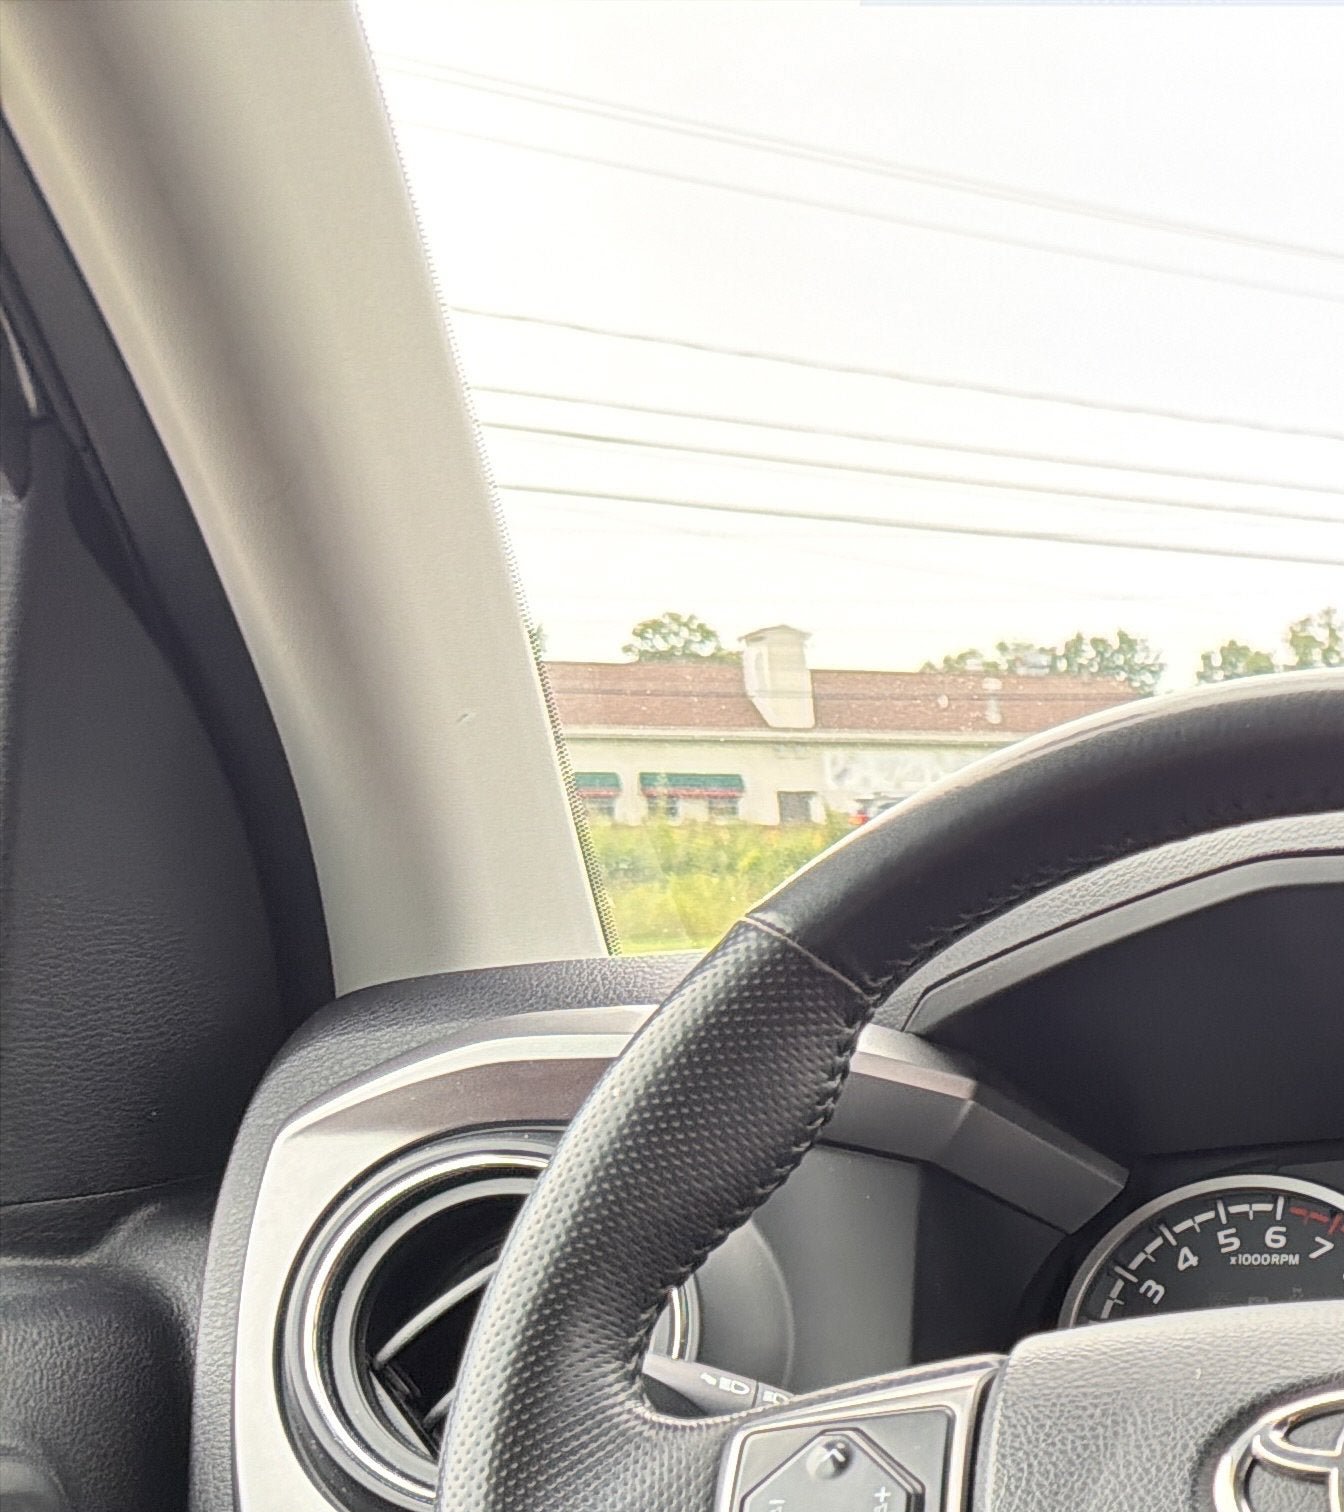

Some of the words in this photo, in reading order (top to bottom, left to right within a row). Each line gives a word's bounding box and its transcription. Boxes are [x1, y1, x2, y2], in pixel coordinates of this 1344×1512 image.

[1216, 1228, 1241, 1253] 5
[1264, 1226, 1287, 1249] 6
[1308, 1237, 1335, 1259] 7
[1177, 1246, 1199, 1271] 4
[1229, 1254, 1300, 1265] x1000RPM
[1139, 1279, 1166, 1305] 3
